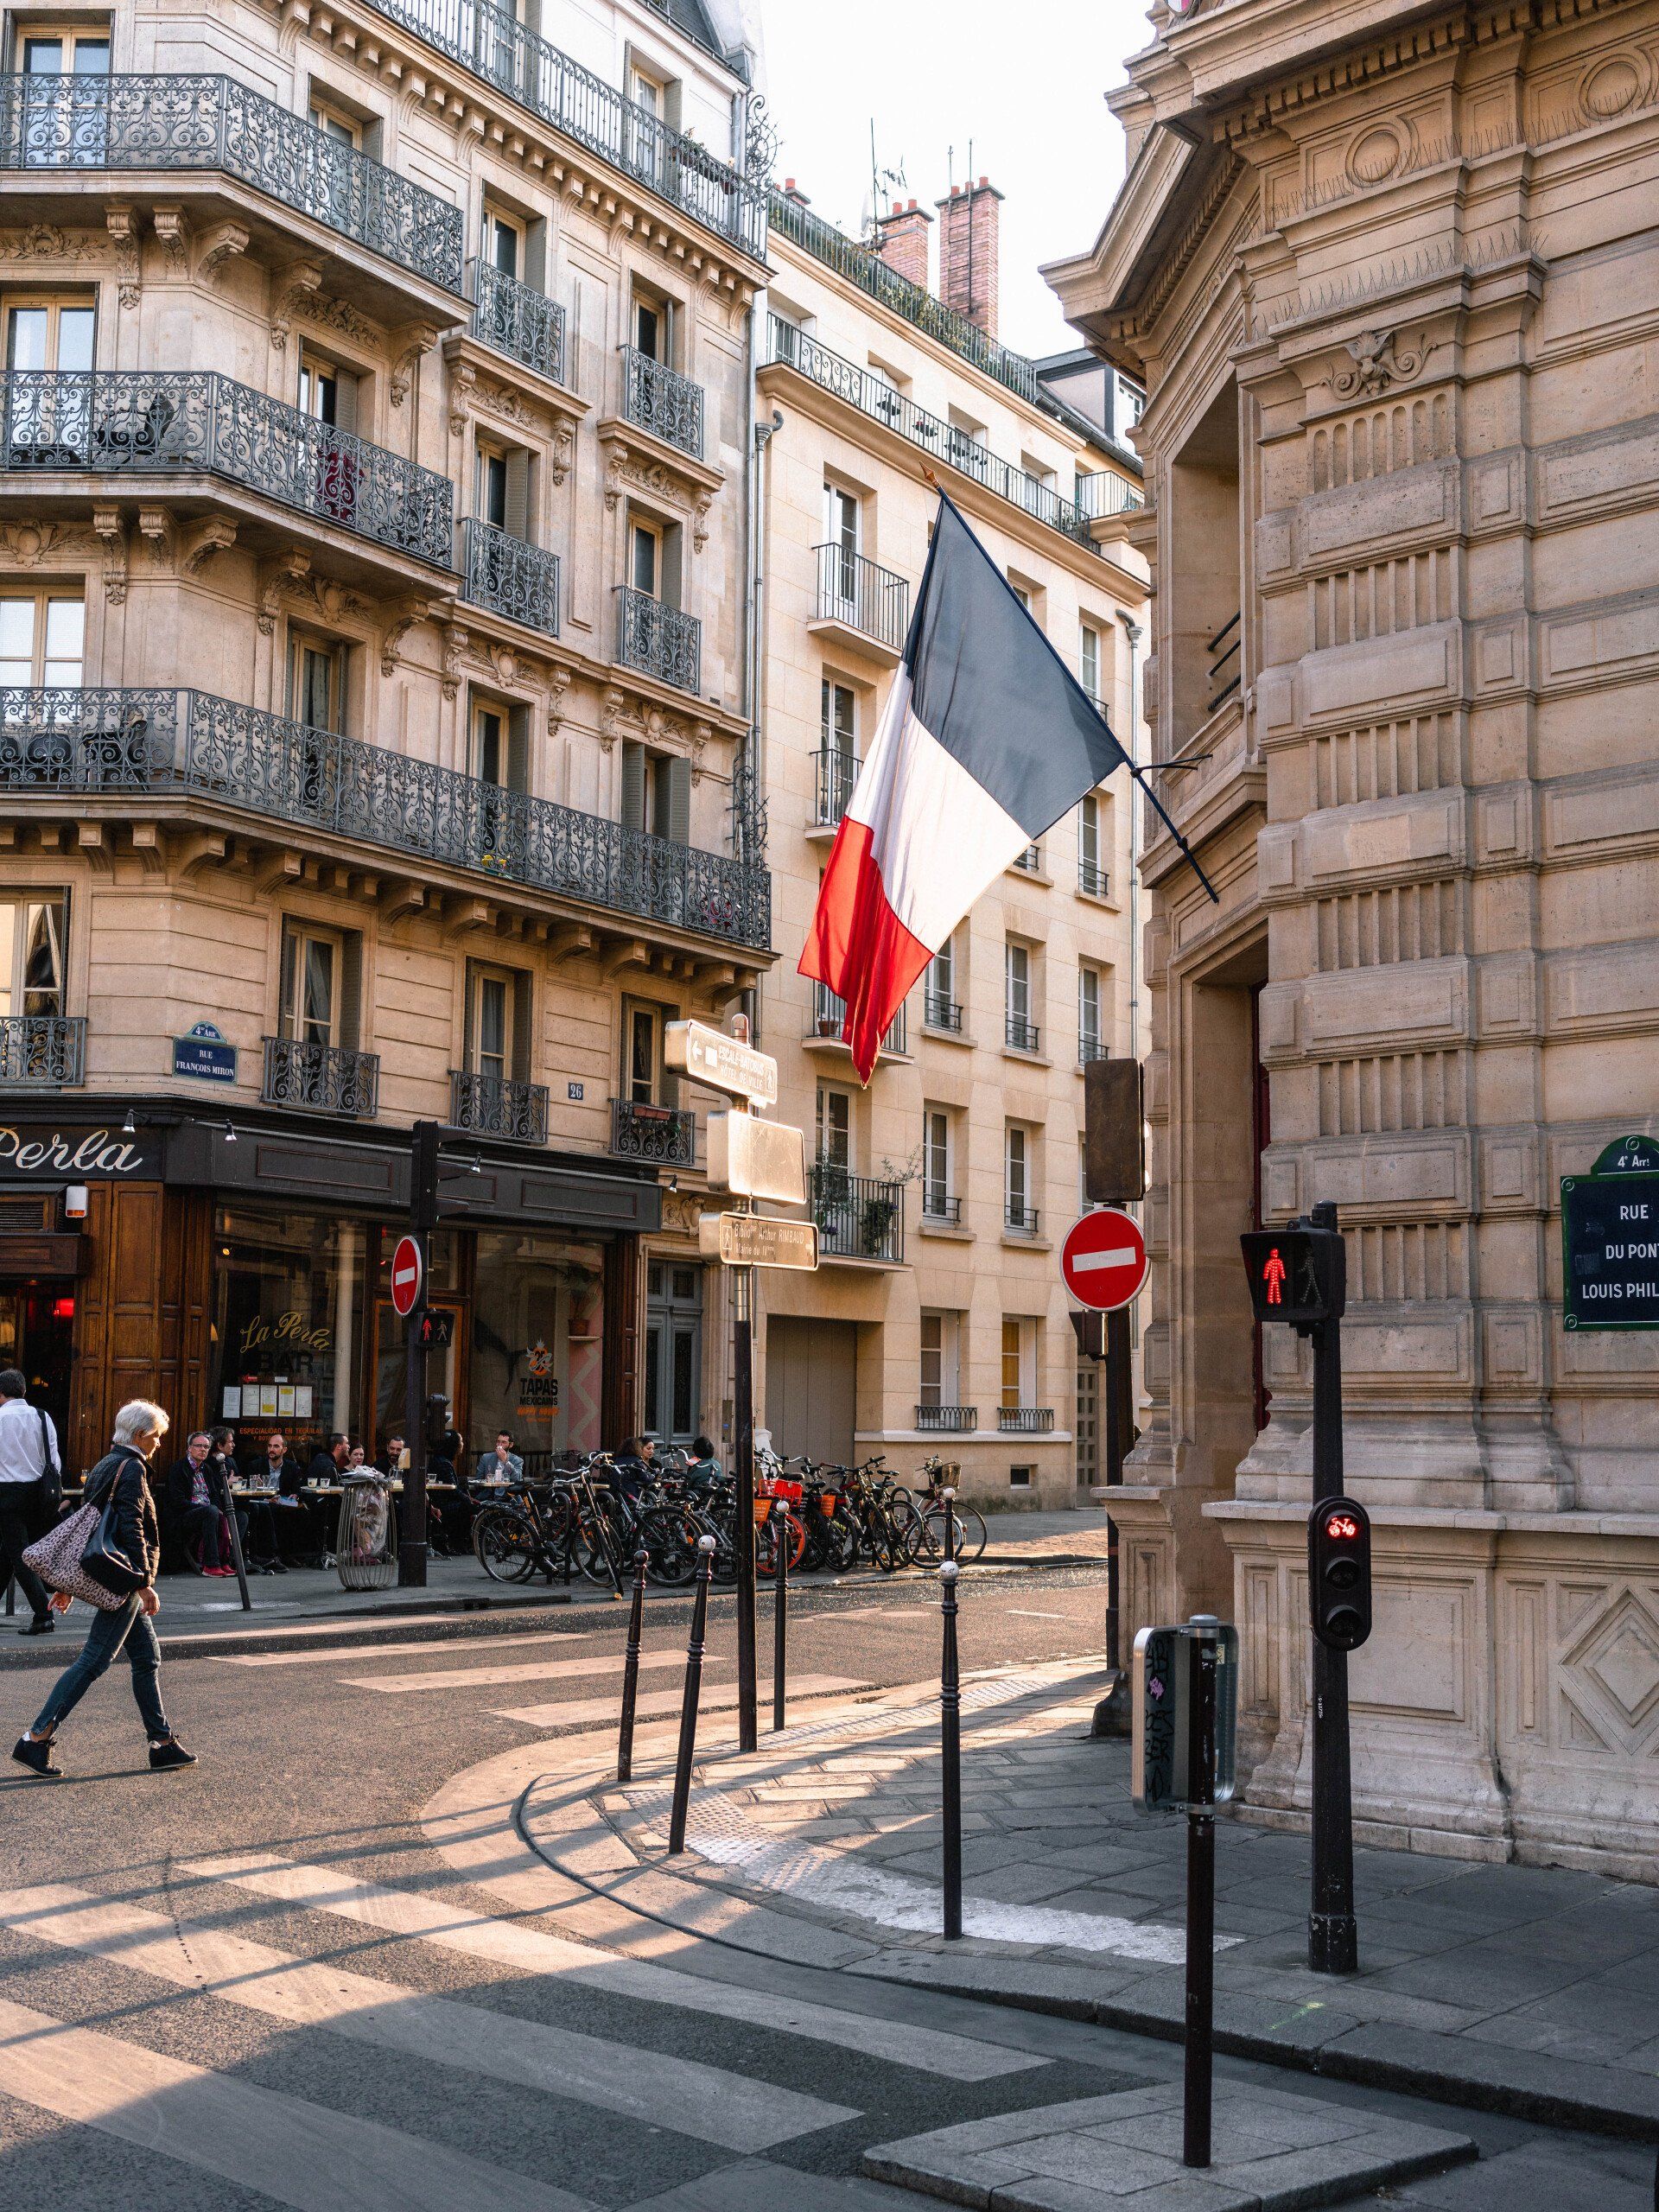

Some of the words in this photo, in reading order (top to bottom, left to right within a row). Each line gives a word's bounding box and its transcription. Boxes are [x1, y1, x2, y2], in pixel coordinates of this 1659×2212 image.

[199, 1049, 213, 1059] RUE
[175, 1060, 212, 1074] FRANÇOIS
[212, 1065, 234, 1077] MIRON
[739, 1071, 747, 1084] DE
[748, 1076, 763, 1090] VILLE
[570, 1084, 582, 1099] 26
[1620, 1204, 1649, 1220] RUE
[759, 1226, 777, 1242] Arthur
[779, 1229, 804, 1244] RIMBAUD
[734, 1242, 752, 1255] Mairie
[753, 1244, 760, 1255] du
[1605, 1244, 1624, 1259] DU
[1582, 1283, 1623, 1300] LOUIS
[239, 1315, 270, 1354] La
[274, 1311, 332, 1351] Perla
[258, 1351, 314, 1374] BAR
[520, 1377, 558, 1395] TAPAS
[519, 1396, 558, 1406] MEXICAINS
